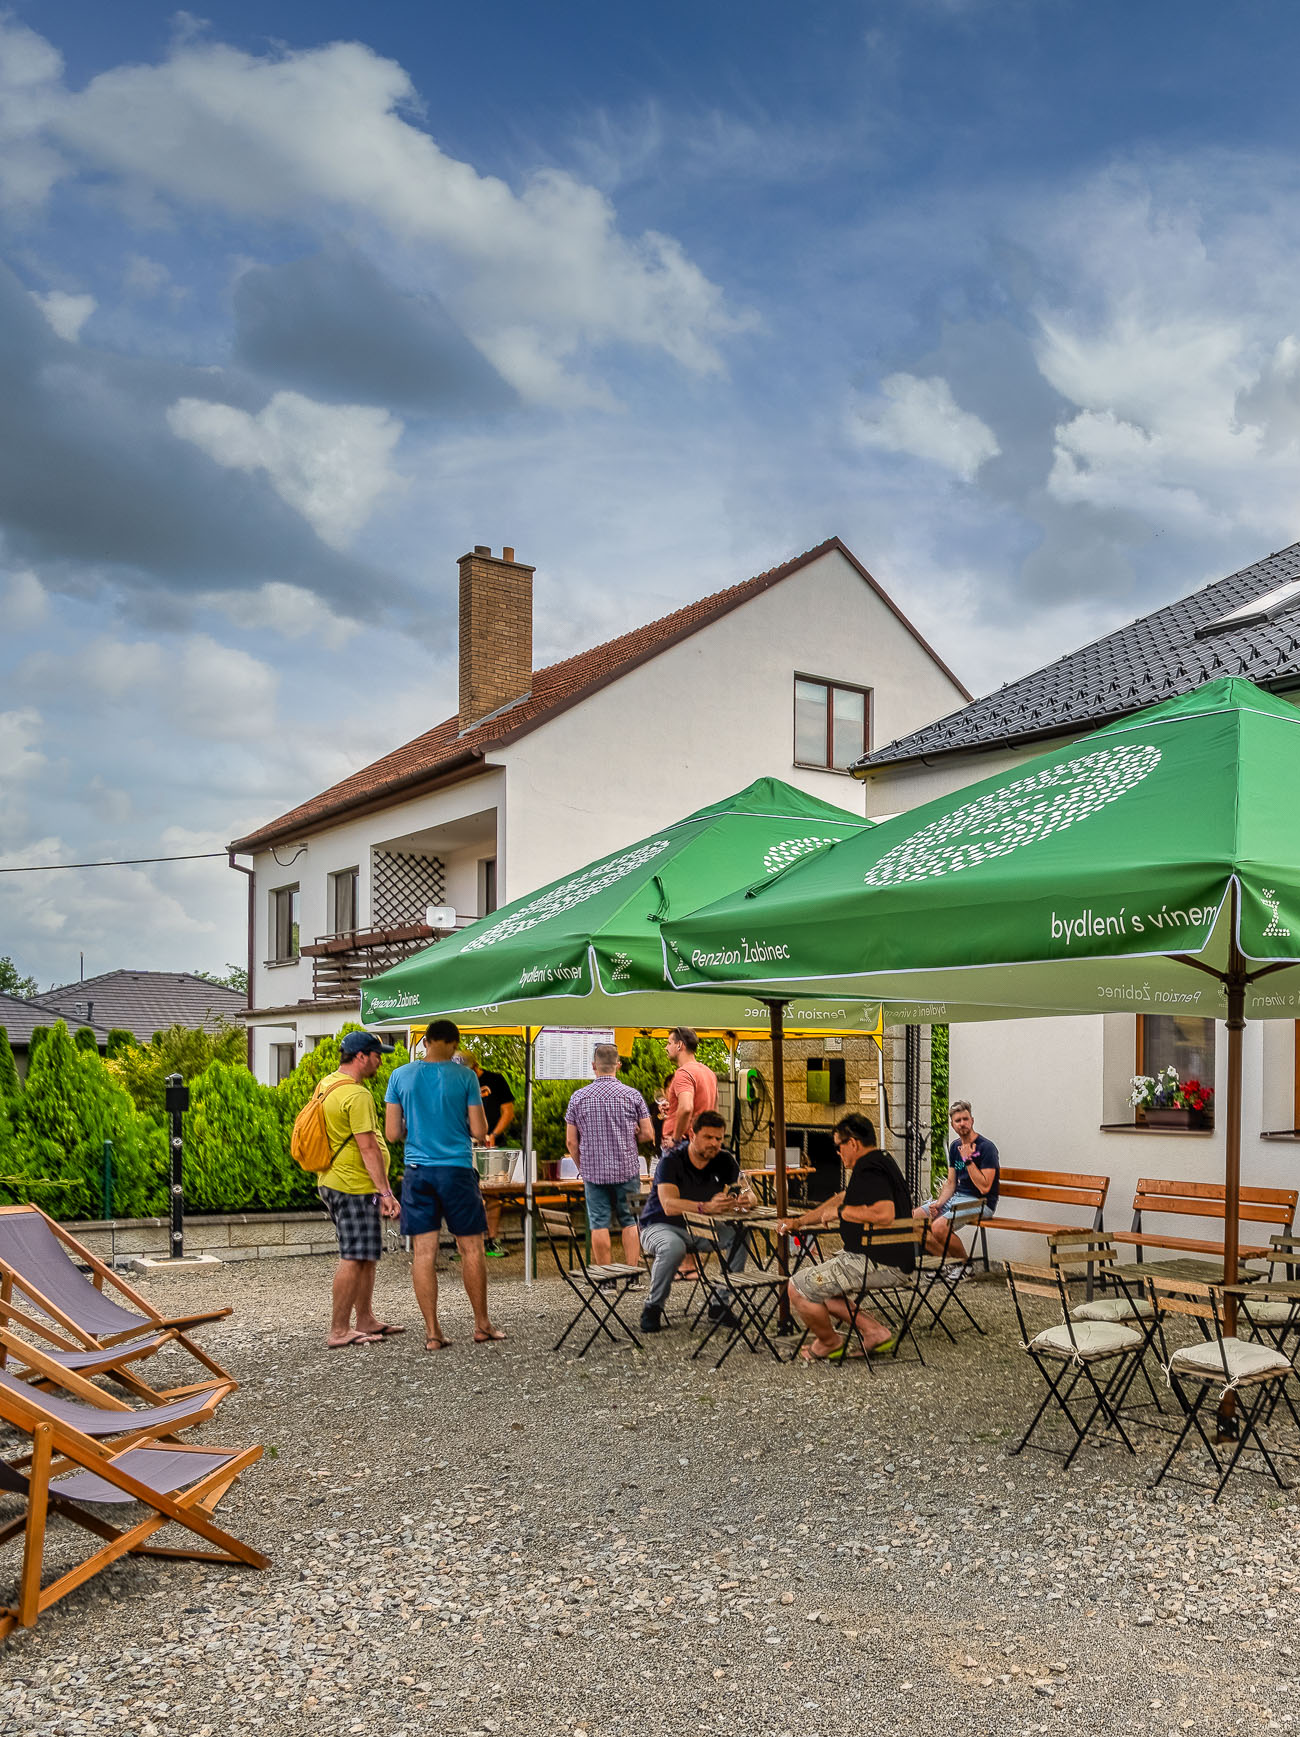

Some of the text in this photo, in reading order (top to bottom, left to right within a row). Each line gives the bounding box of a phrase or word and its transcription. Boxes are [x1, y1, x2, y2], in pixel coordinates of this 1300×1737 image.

[1051, 907, 1126, 945] bydlení
[1131, 915, 1145, 932] s
[692, 946, 741, 967] Penzion
[741, 938, 791, 964] Žabinec
[547, 969, 554, 981] s
